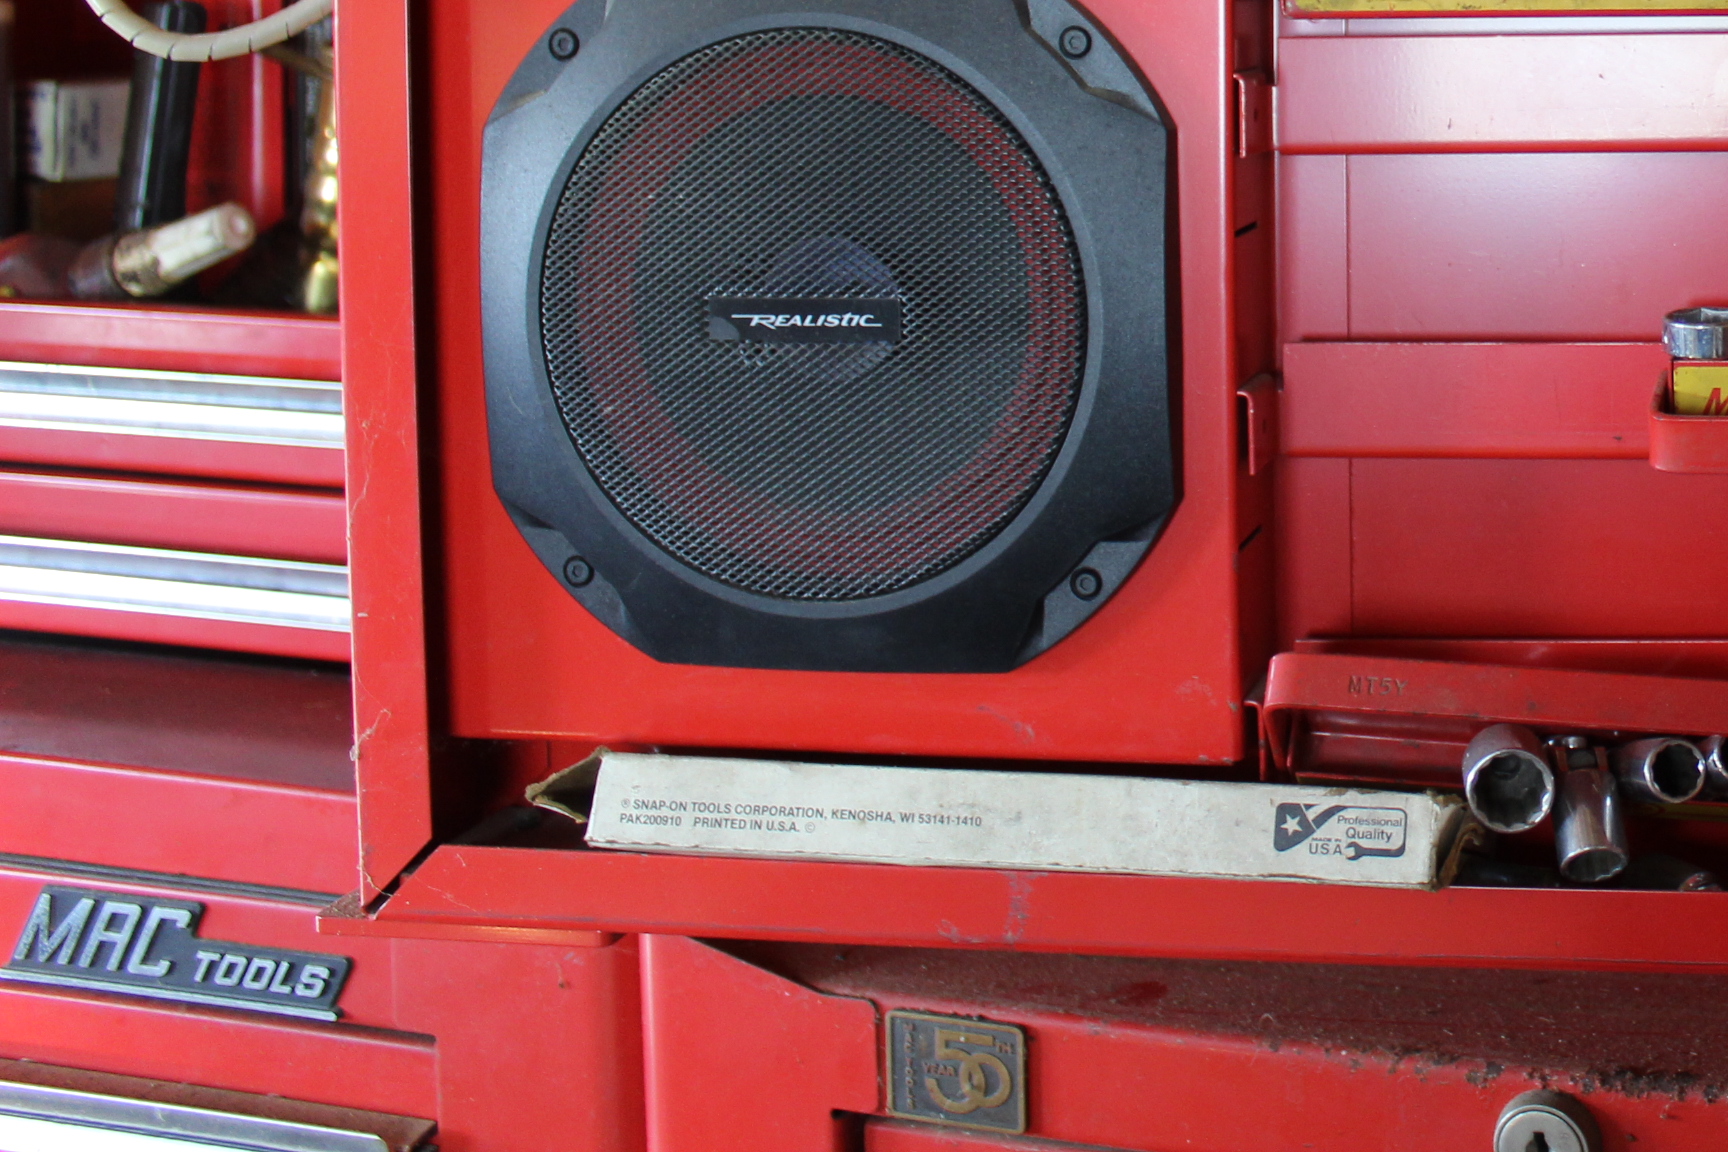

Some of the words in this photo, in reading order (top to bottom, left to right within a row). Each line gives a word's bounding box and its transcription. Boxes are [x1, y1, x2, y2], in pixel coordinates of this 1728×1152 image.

[731, 312, 882, 330] REALISTIC
[1349, 675, 1408, 696] MT5Y
[619, 813, 682, 827] PAK200910
[693, 816, 747, 830] PRINTED
[750, 819, 762, 830] IN
[766, 820, 800, 833] U.S.A.
[632, 799, 687, 812] SNAP-ON
[691, 801, 732, 814] TOOLS
[734, 804, 827, 820] CORPORATION,
[831, 809, 896, 823] KENOSHA,
[899, 811, 915, 823] WI
[918, 813, 982, 827] 53141-1410
[1337, 815, 1403, 827] Professional
[1345, 826, 1393, 843] Quality
[14, 892, 193, 977] MAC
[194, 949, 330, 998] TOOLS
[922, 1062, 956, 1076] YEAR
[924, 1028, 1011, 1114] 50
